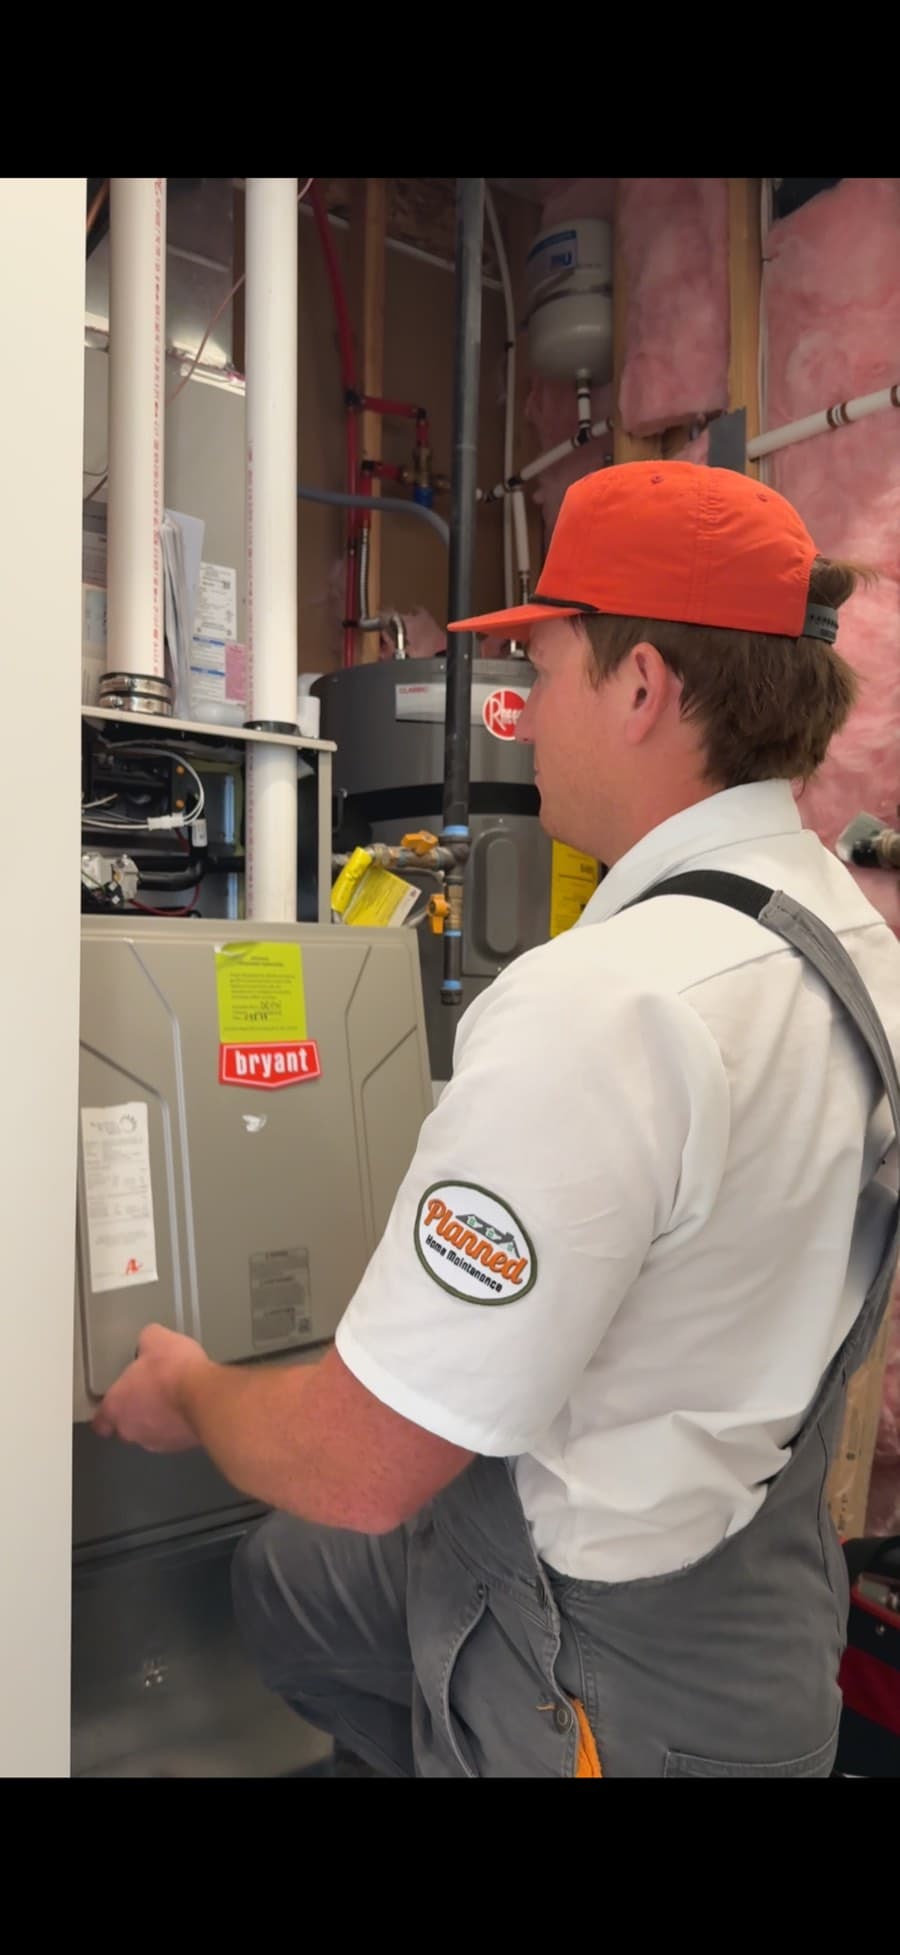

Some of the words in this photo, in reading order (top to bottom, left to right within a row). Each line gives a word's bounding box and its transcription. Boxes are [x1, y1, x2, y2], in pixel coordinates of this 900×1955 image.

[235, 1047, 309, 1078] bryant
[424, 1199, 528, 1285] Planned
[425, 1234, 447, 1256] Home
[446, 1249, 503, 1293] Maintenance
